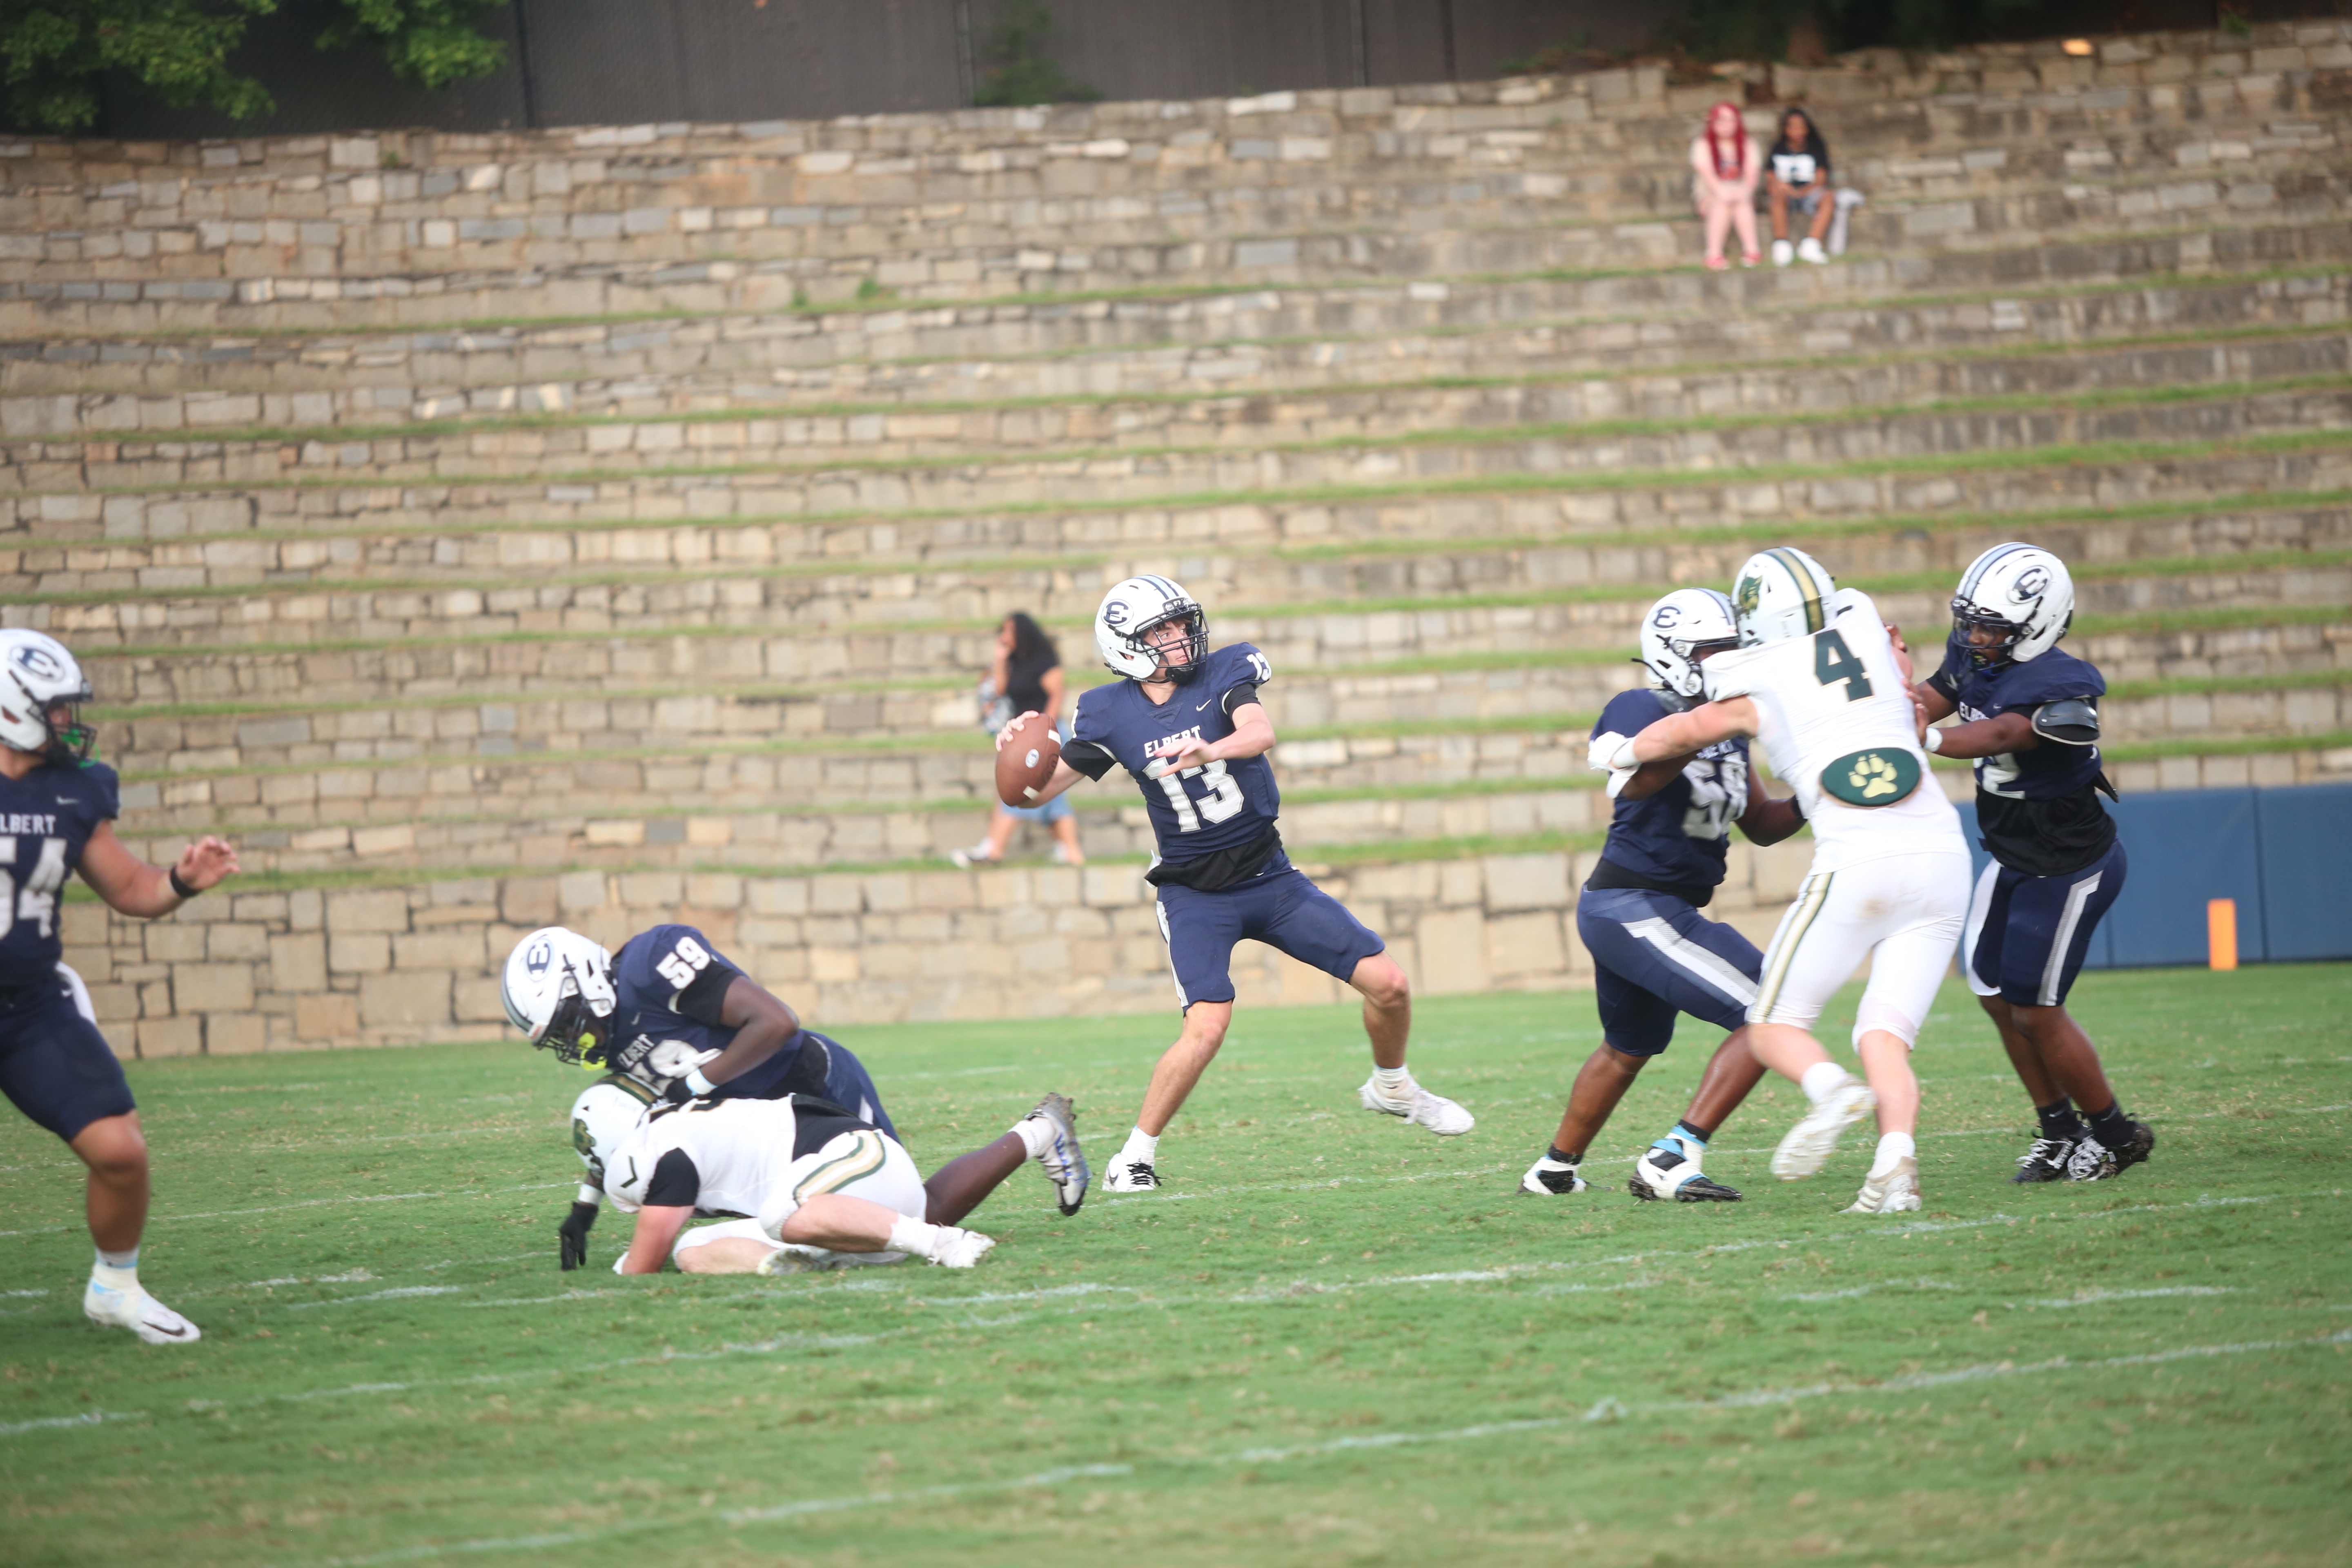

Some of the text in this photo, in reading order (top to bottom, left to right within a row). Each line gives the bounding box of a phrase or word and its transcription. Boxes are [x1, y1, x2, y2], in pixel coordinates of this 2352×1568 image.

[1246, 652, 1272, 681] 13
[1813, 628, 1876, 704] 4
[1142, 756, 1245, 832] 13
[655, 936, 710, 990] 59
